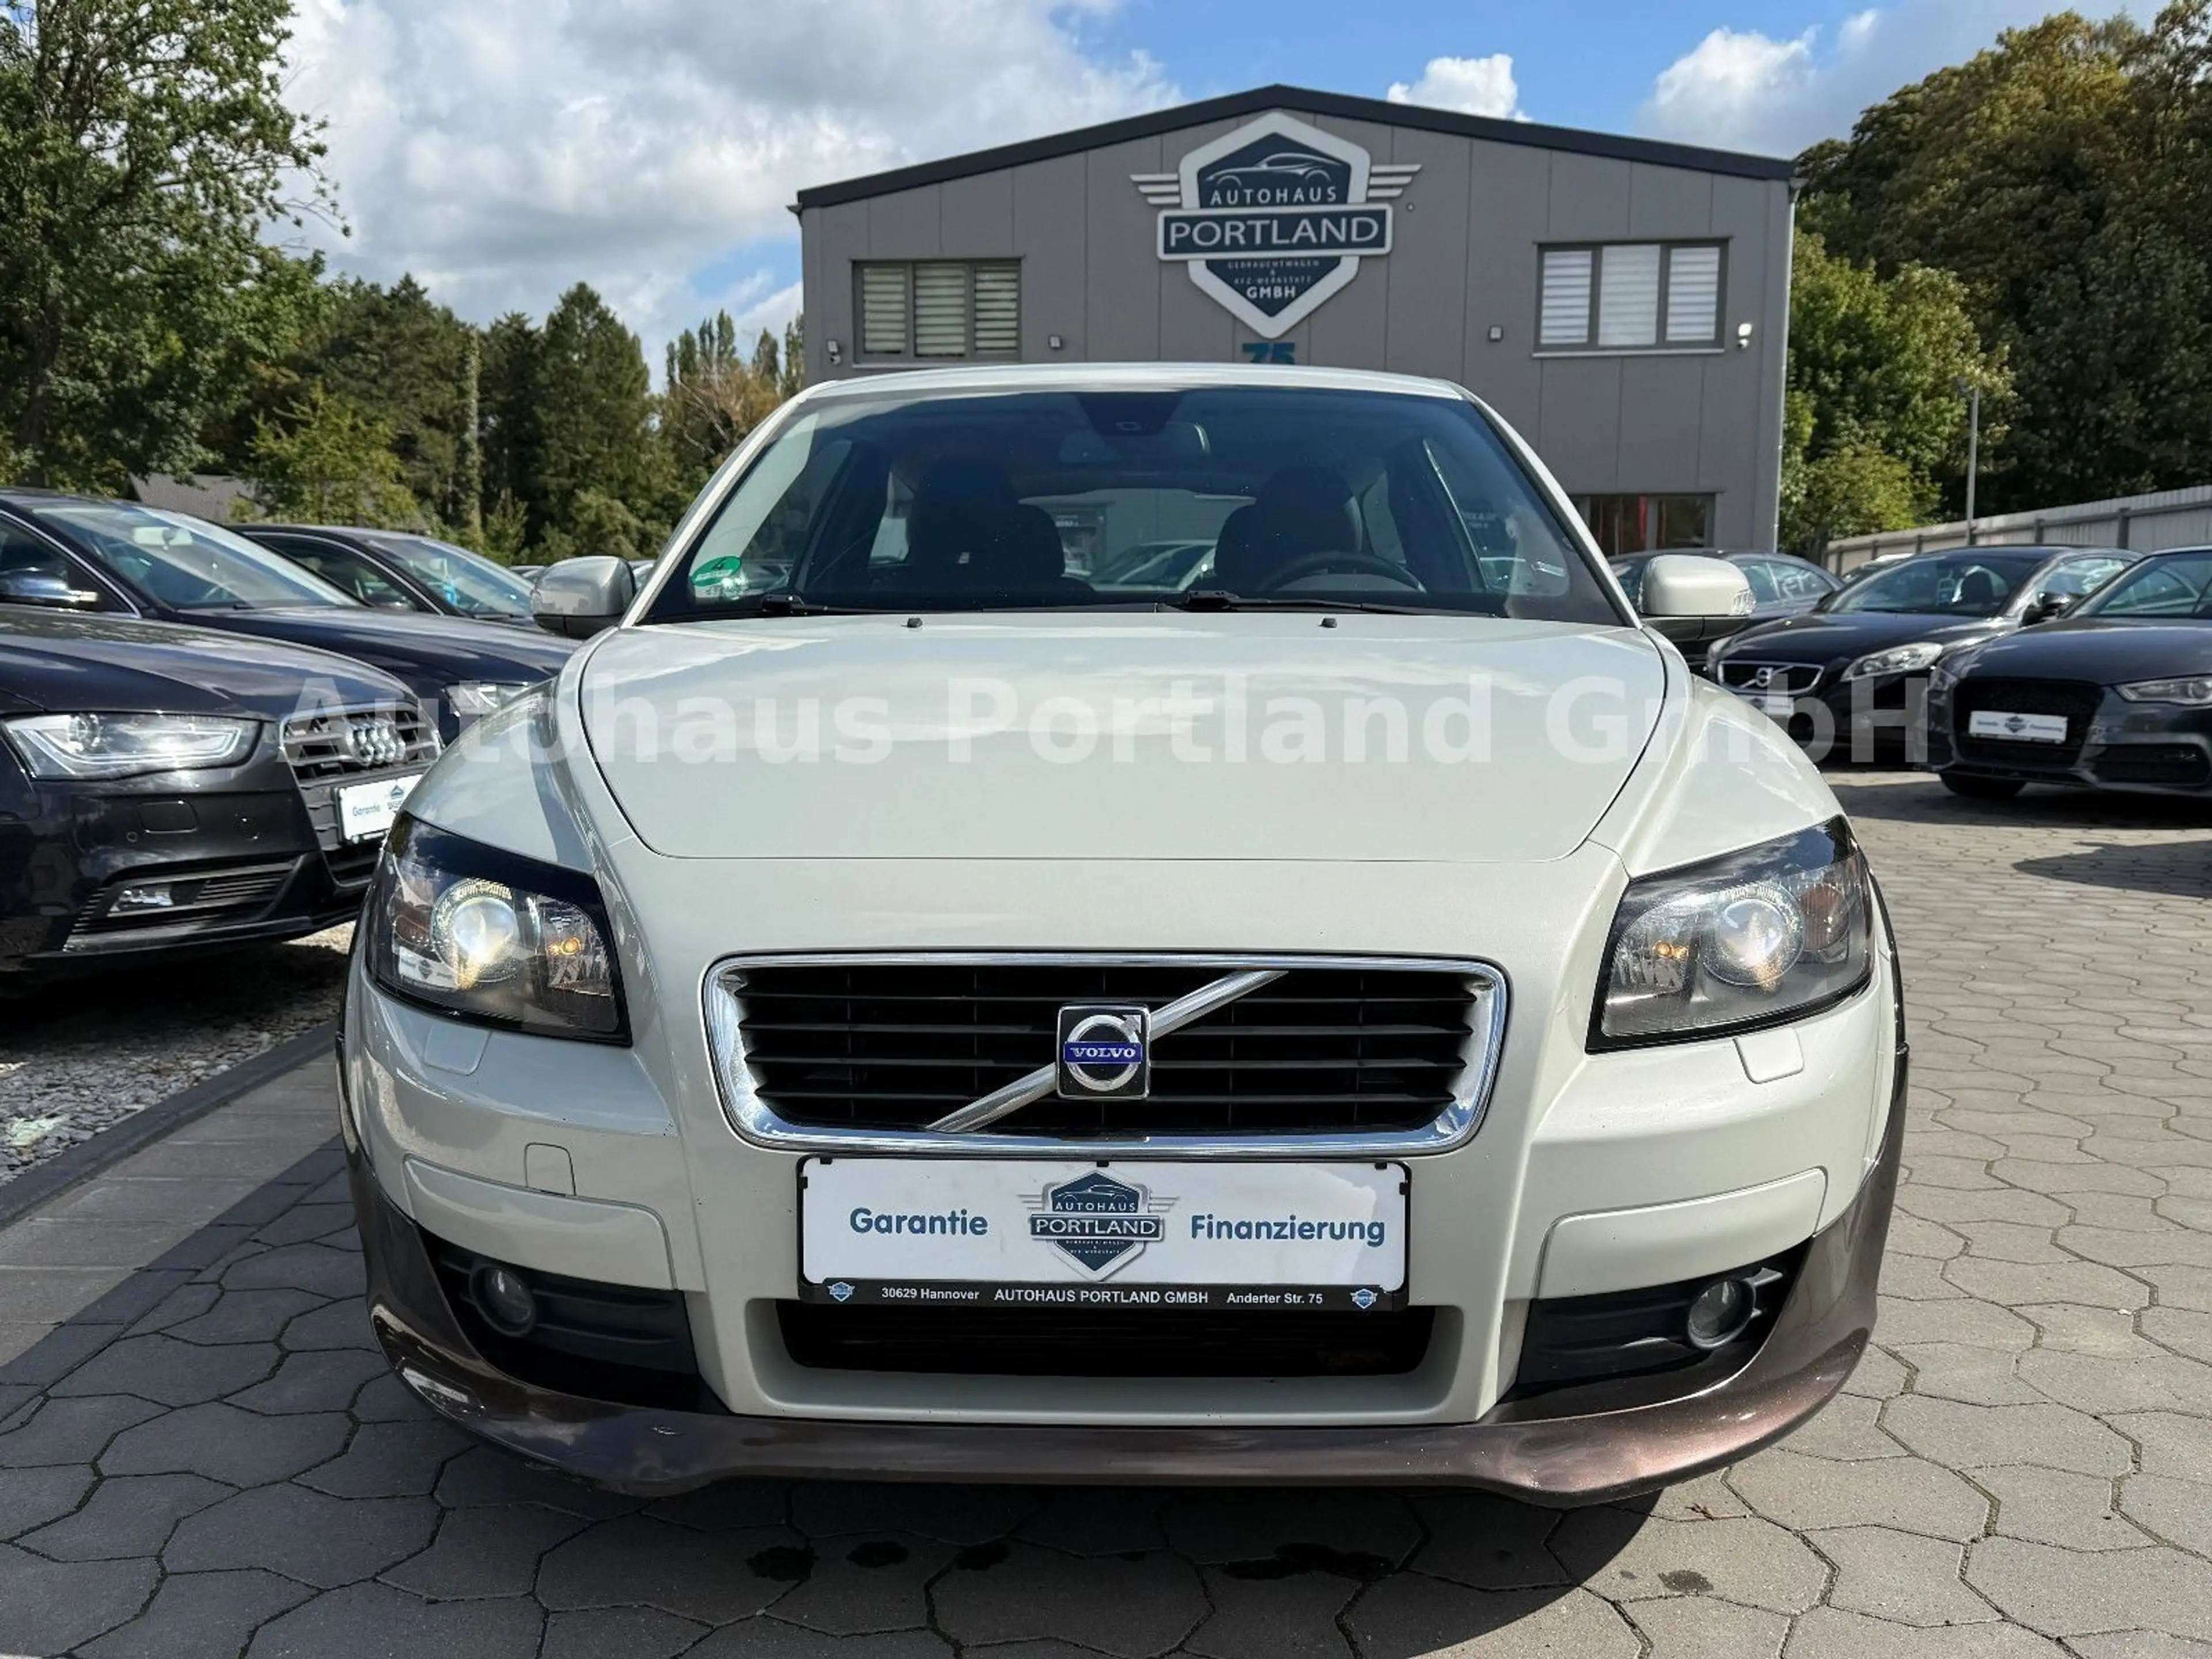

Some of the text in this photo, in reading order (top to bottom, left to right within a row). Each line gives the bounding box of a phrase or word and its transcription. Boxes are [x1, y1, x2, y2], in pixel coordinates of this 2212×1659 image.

[1210, 186, 1337, 206] AUTOHAUS
[1169, 217, 1379, 248] PORTLAND
[1246, 286, 1296, 299] GMBH
[1070, 1047, 1136, 1058] VOLVO
[1055, 1202, 1136, 1211] AUTOHAUS
[850, 1207, 988, 1236] Garantie
[1036, 1218, 1157, 1235] PORTLAND
[1191, 1214, 1385, 1248] Finanzierung
[882, 1287, 1323, 1305] 30629 Hannover AUTOHAUS PORTLAND GMBH Anderter Str. 75
